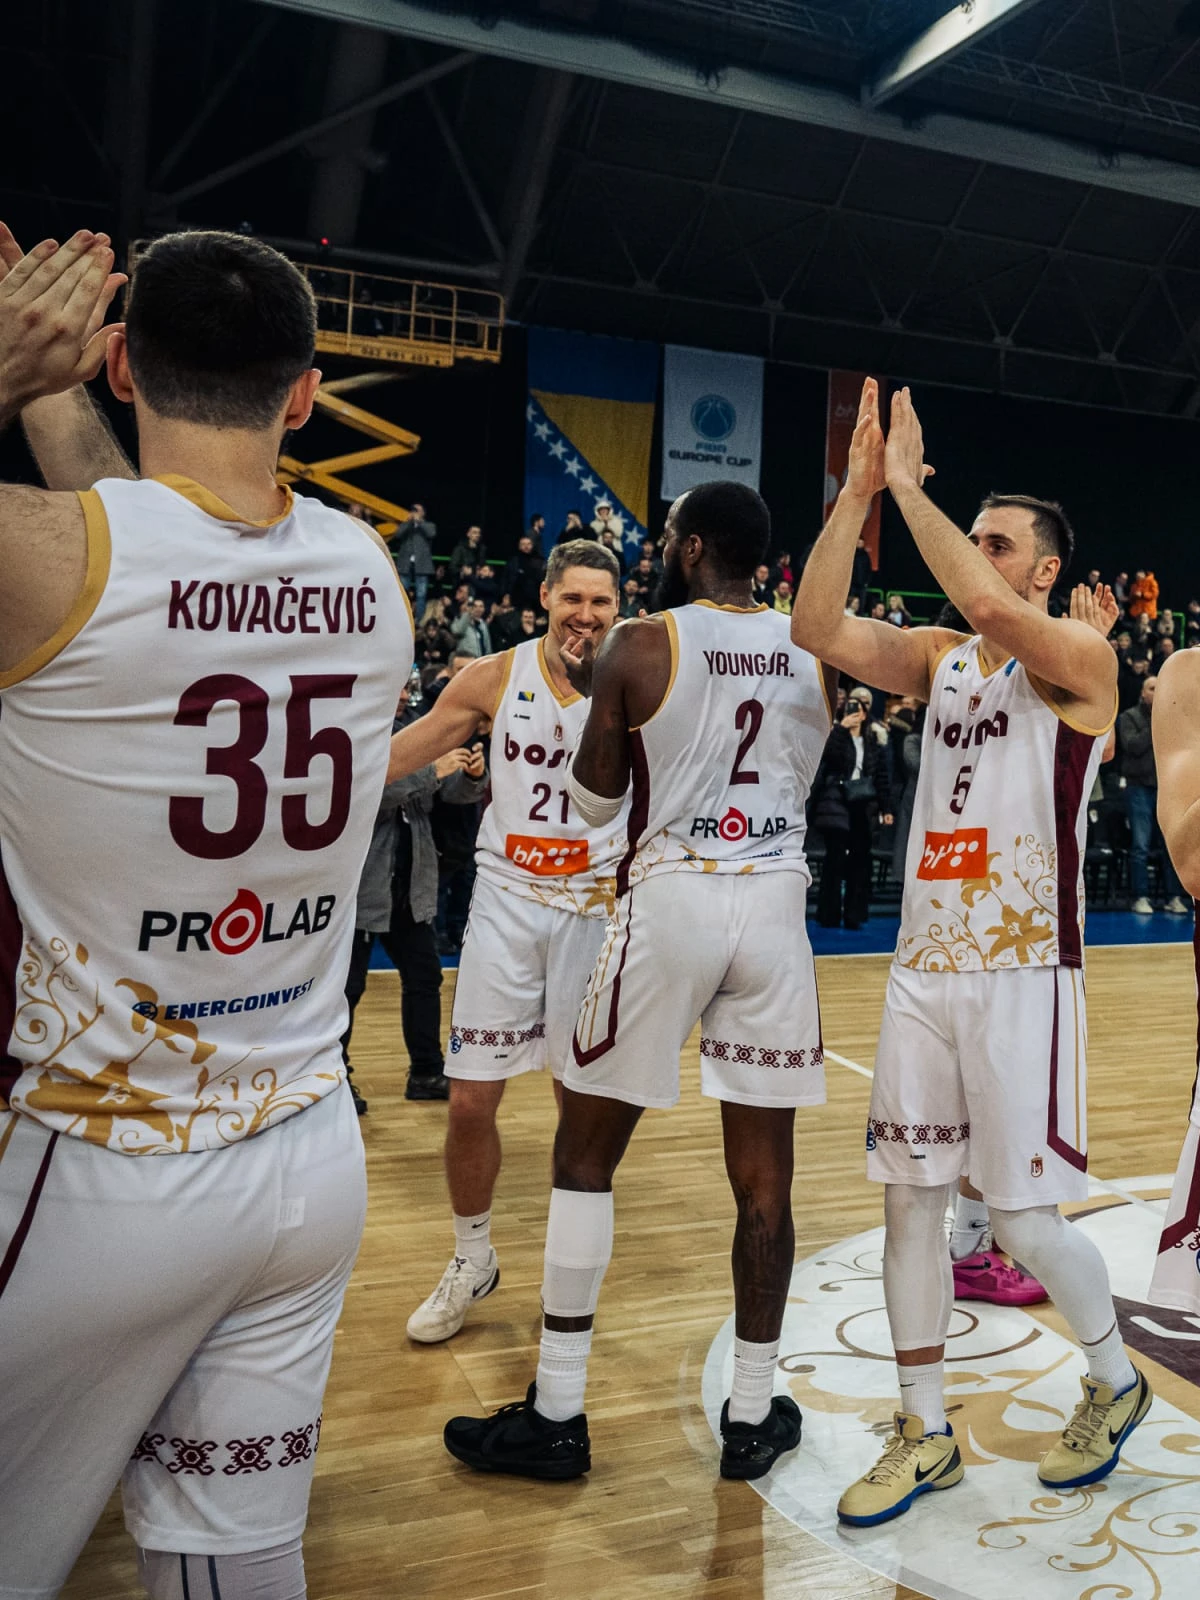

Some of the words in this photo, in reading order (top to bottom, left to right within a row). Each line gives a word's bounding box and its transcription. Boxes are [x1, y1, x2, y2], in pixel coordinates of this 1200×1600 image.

[669, 450, 722, 464] EUROPE
[726, 456, 752, 467] CUP
[168, 577, 376, 634] KOVAČEVIĆ
[702, 650, 766, 677] YOUNG
[766, 651, 795, 678] JR.
[504, 732, 574, 769] bos
[729, 698, 765, 786] 2
[168, 674, 358, 859] 35
[528, 782, 570, 824] 21
[950, 766, 972, 815] 5
[690, 807, 788, 842] PROLAB
[512, 844, 544, 867] bh
[138, 889, 336, 956] PROLAB
[164, 976, 316, 1021] ENERGOINVEST
